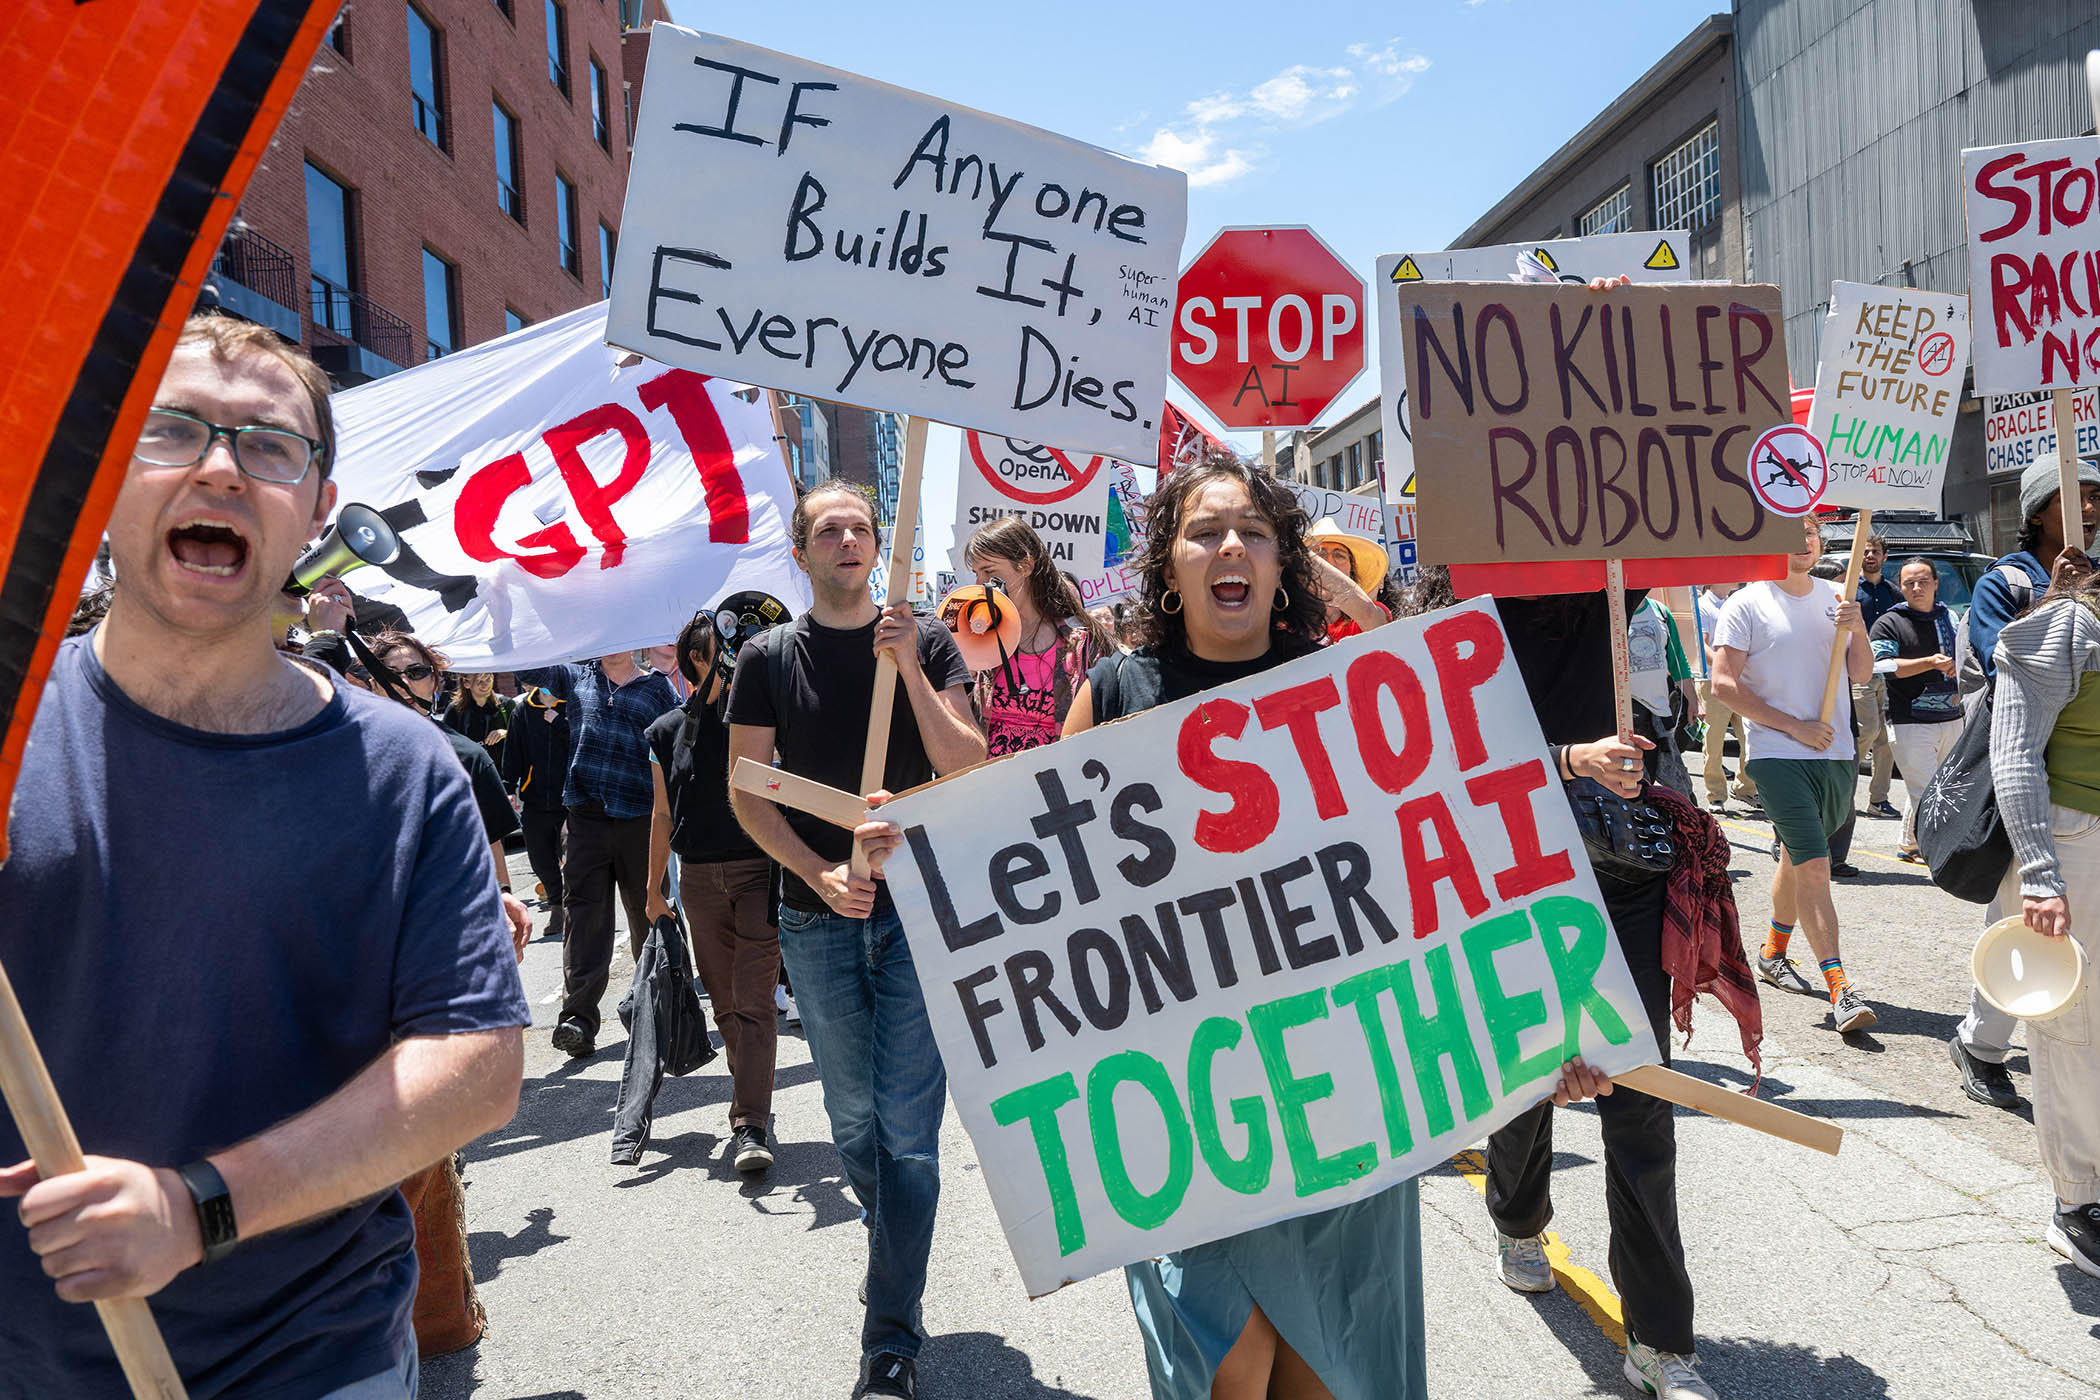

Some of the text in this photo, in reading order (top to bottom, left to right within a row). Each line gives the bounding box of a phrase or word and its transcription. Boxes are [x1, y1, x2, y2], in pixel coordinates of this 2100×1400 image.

[672, 56, 1148, 246] IF Anyone
[1975, 152, 2100, 242] STO
[786, 171, 1102, 325] Builds It,
[1123, 283, 1168, 308] human
[1128, 306, 1159, 327] AI
[1856, 301, 1935, 344] KEEP
[1991, 250, 2100, 347] RACI
[647, 244, 1152, 429] Everyone Dies.
[1179, 294, 1356, 365] STOP
[1856, 341, 1915, 375] THE
[1232, 364, 1299, 407] AI
[1414, 302, 1784, 420] NO KILLER
[1837, 371, 1950, 417] FUTURE
[1986, 406, 2047, 442] ORACLE
[2052, 393, 2096, 428] RK
[1827, 413, 1947, 466] HUMAN
[1988, 425, 2099, 470] CHASE CEER
[454, 368, 749, 579] GPT
[1489, 425, 1764, 551] ROBOTS
[1828, 463, 1933, 487] STOP AI NOW!
[1032, 512, 1100, 534] DOWN
[1346, 503, 1381, 531] THE
[903, 758, 1177, 953] Let's
[1177, 610, 1505, 854] STOP
[954, 758, 1576, 1068] FRONTIER AI
[990, 895, 1631, 1257] TOGETHER
